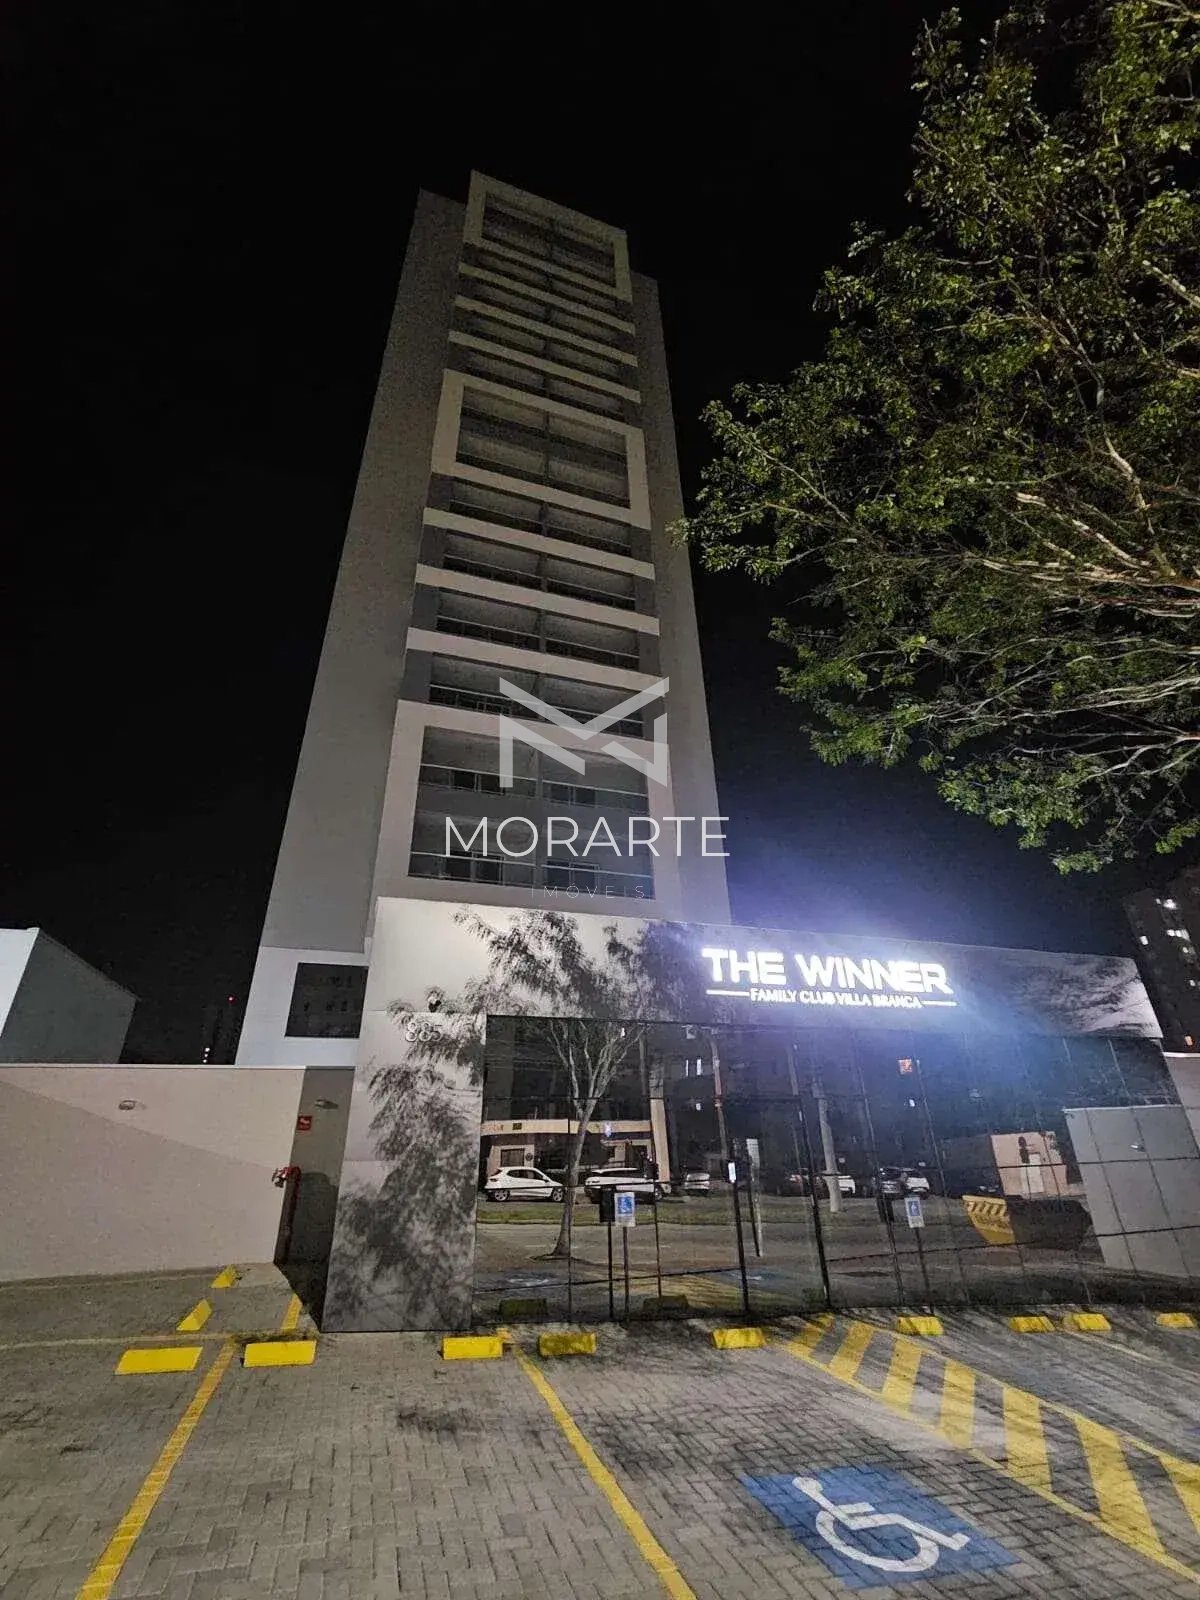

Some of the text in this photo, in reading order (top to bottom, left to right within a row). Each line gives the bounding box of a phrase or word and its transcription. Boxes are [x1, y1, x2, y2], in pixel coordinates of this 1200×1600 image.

[702, 948, 954, 994] THE WINNER
[750, 988, 797, 1003] FAMILY
[799, 990, 835, 1005] CLUB
[835, 992, 872, 1007] VILLA
